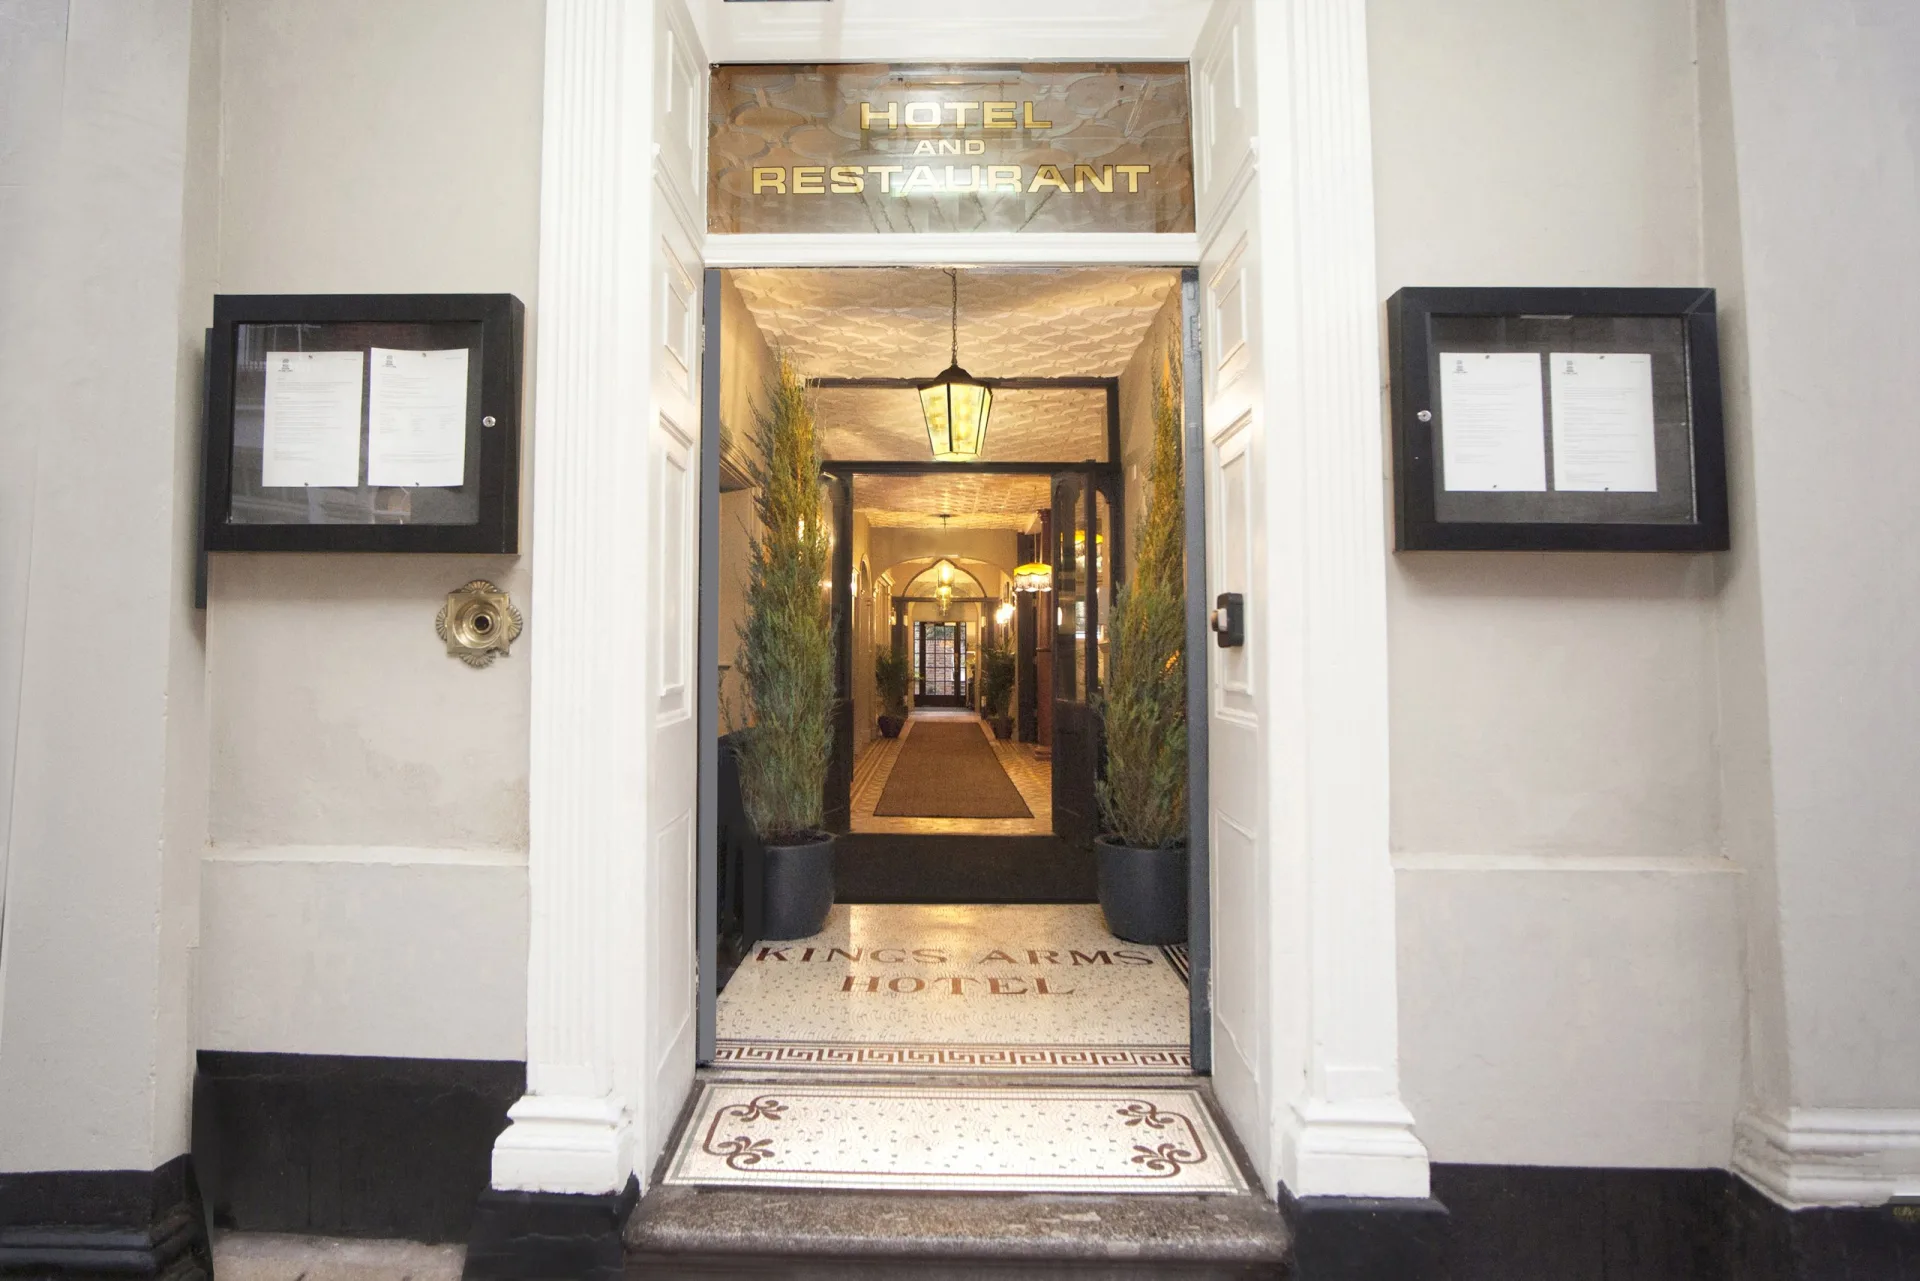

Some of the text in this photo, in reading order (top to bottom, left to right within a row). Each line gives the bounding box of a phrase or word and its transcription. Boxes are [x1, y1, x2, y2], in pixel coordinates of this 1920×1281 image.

[860, 101, 1052, 129] HOTEL
[912, 139, 986, 155] AND
[752, 164, 1151, 194] RESTAURANT
[755, 947, 1154, 966] KINGS ARMS
[839, 975, 1075, 996] HOTEL
